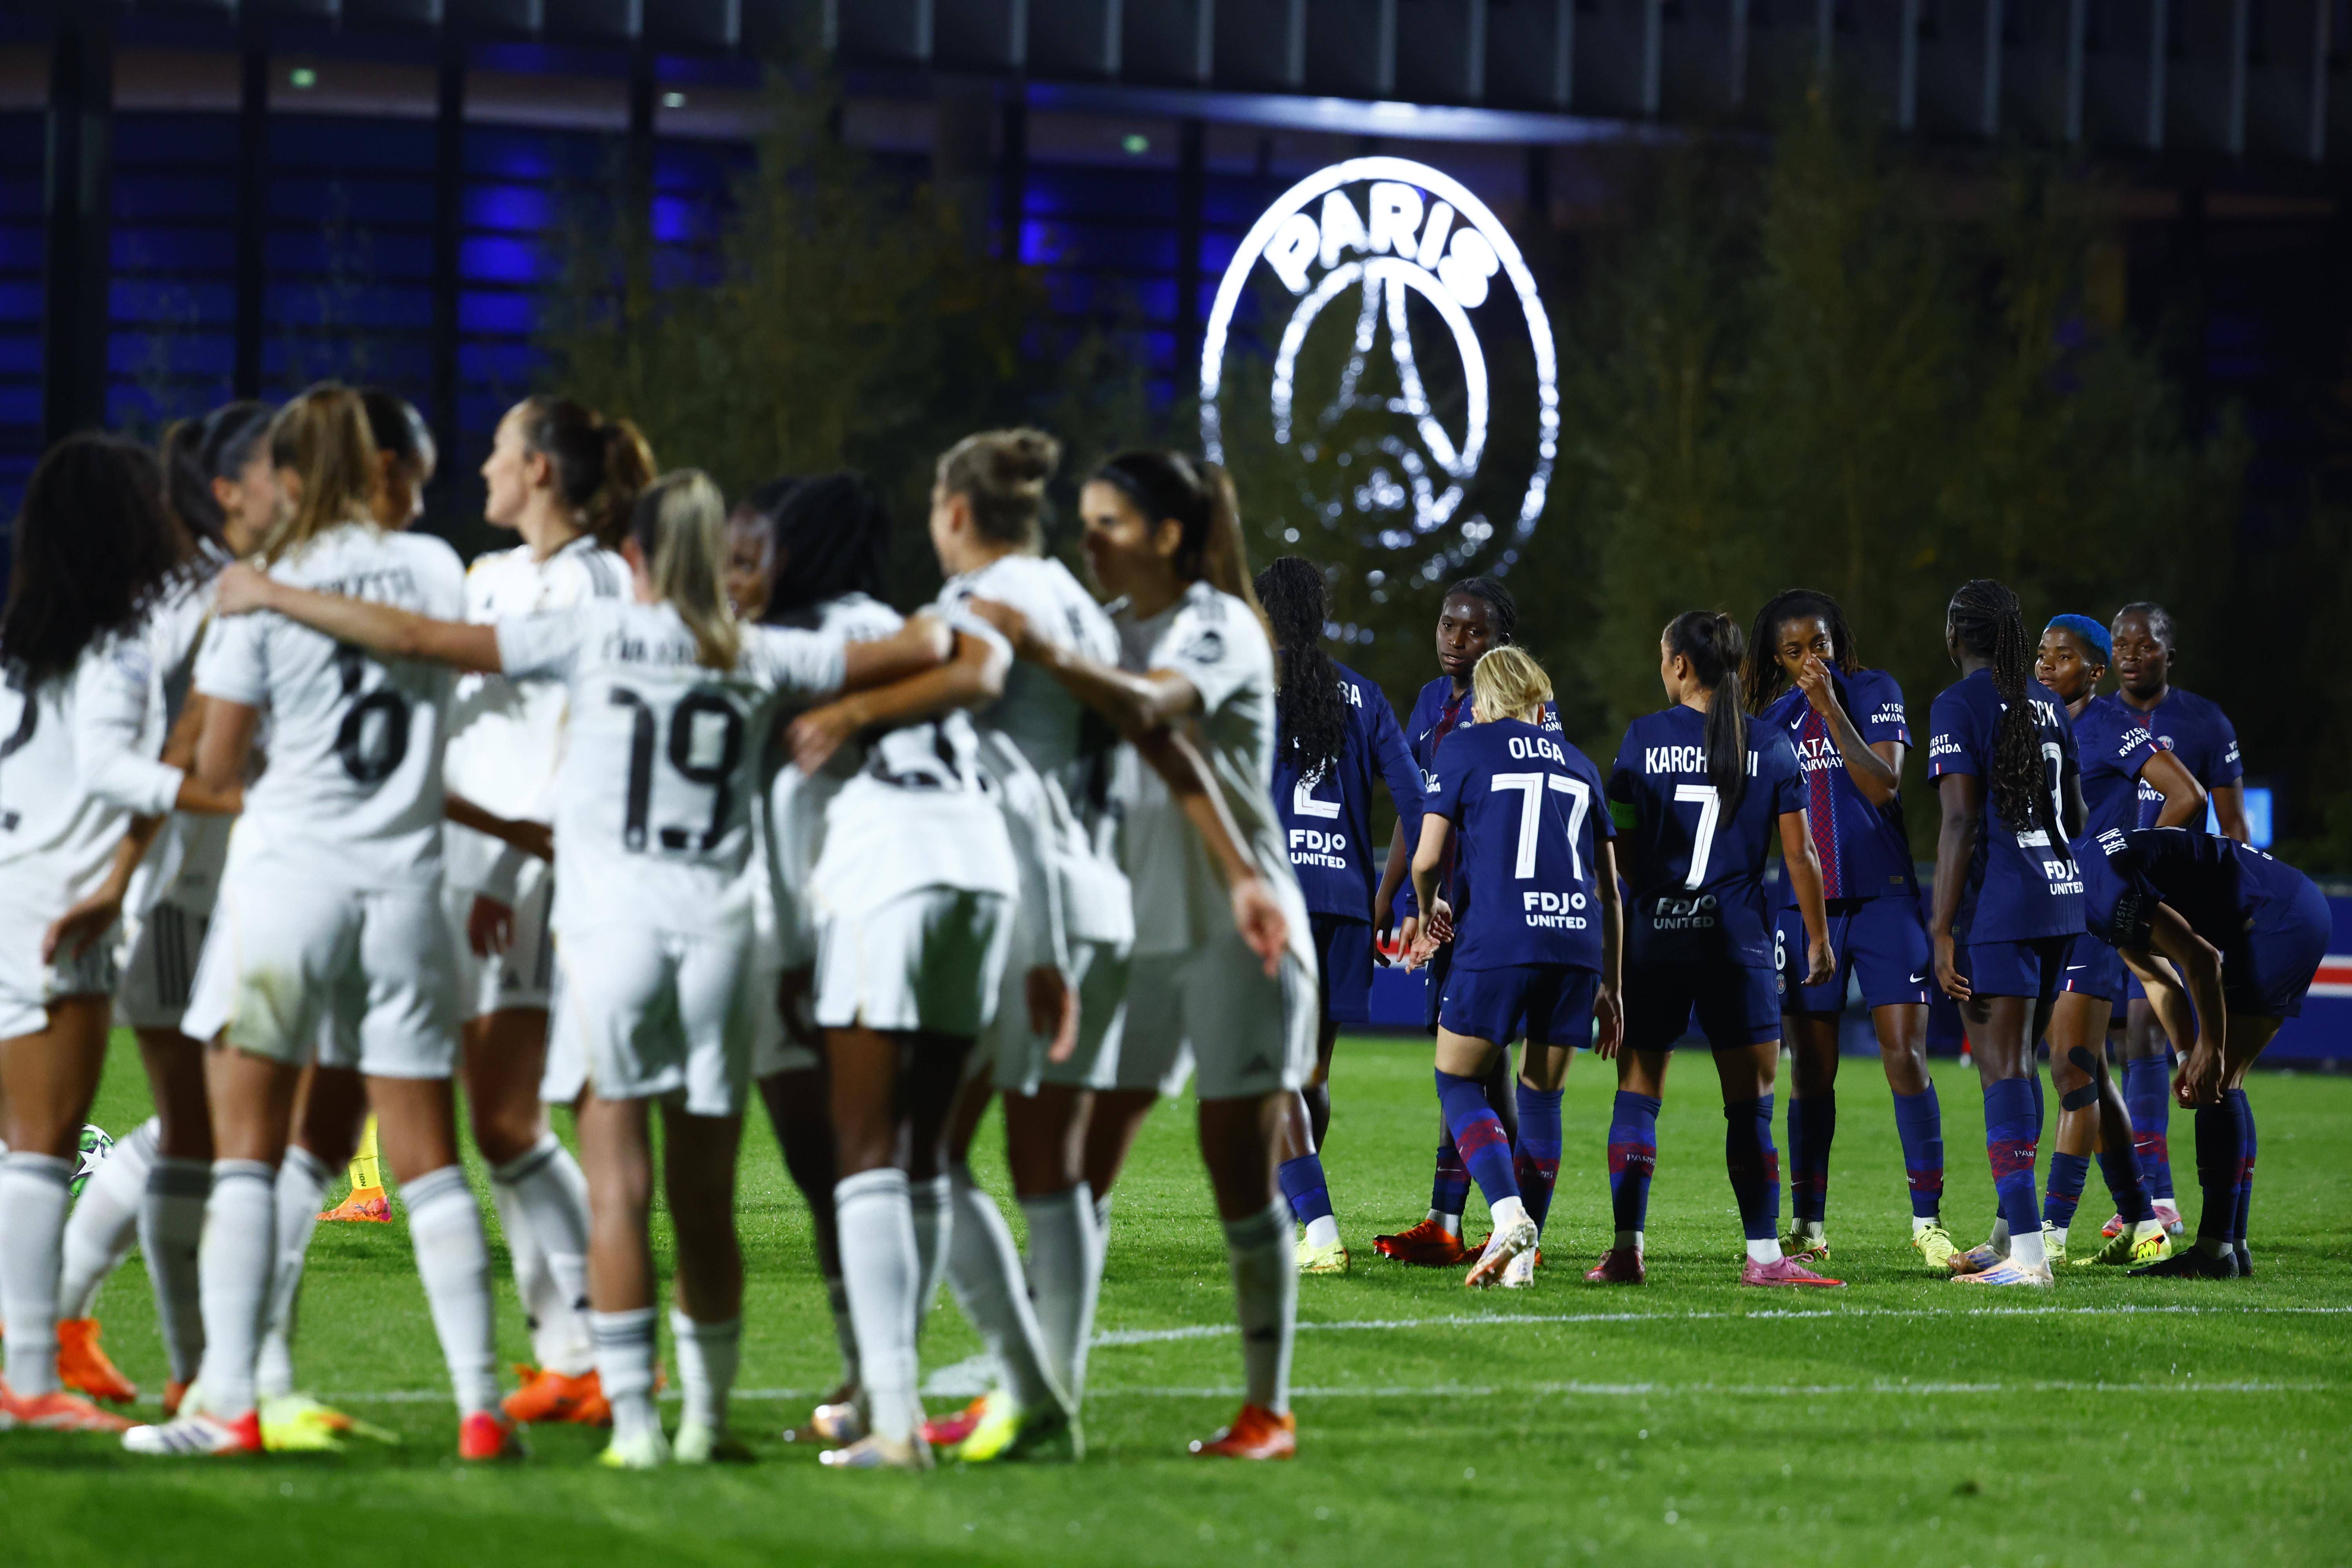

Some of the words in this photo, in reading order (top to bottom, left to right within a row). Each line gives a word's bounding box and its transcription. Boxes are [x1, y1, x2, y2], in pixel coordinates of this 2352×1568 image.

[1263, 182, 1499, 308] PARIS
[1871, 713, 1906, 724] RWAND
[1882, 703, 1904, 714] VISIT
[1509, 737, 1565, 765] OLGA
[1791, 737, 1840, 762] ATA
[1929, 743, 1962, 759] ANDA
[2119, 733, 2153, 757] RWAN
[609, 684, 742, 852] 19
[1800, 757, 1844, 772] AIRWAY
[1491, 772, 1590, 881] 77
[1674, 784, 1721, 890] 7
[1290, 829, 1346, 853] FDJO
[1290, 852, 1346, 869] UNITED
[2050, 881, 2083, 895] UNITED
[1523, 892, 1586, 915] FDJO
[1656, 895, 1717, 916] FDJO
[1526, 914, 1587, 929] UNITED
[1653, 916, 1715, 929] UNITED
[1774, 929, 1786, 971] 6
[1627, 1154, 1656, 1166] PARIS
